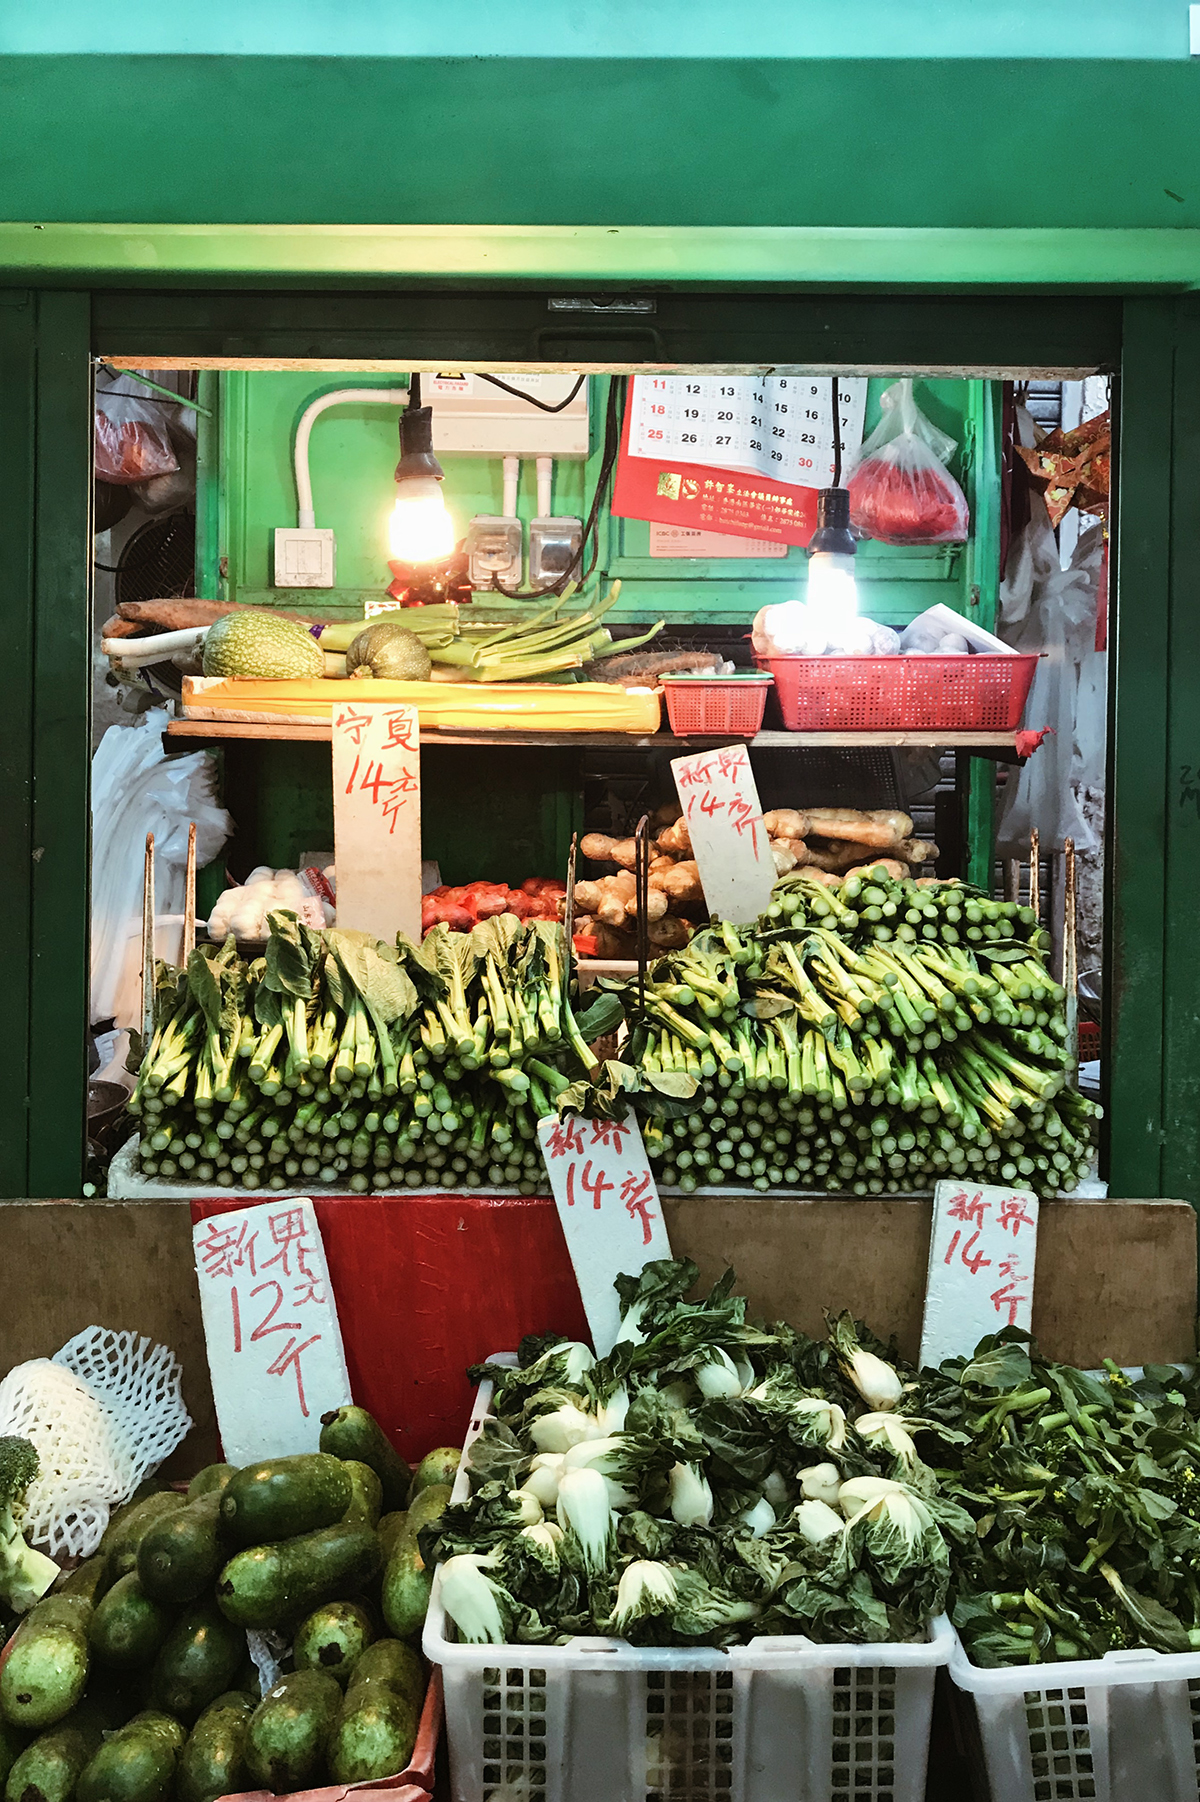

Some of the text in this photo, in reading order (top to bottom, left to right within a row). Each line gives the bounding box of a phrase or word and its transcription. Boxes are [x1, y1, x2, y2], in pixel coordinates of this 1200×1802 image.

[653, 379, 666, 390] 11
[686, 382, 701, 394] 12
[719, 386, 736, 397] 13
[752, 392, 764, 405] 14
[774, 403, 789, 414] 15
[805, 409, 820, 421] 16
[779, 379, 851, 403] 8 9 10
[650, 403, 667, 415] 18
[684, 408, 700, 420] 19
[717, 410, 734, 422] 20
[750, 415, 763, 428] 21
[772, 426, 786, 438] 22
[800, 433, 817, 445] 23
[647, 428, 664, 440] 25
[681, 432, 699, 444] 26
[715, 435, 733, 446] 27
[749, 439, 763, 452] 28
[771, 450, 784, 462] 29
[798, 457, 813, 468] 30
